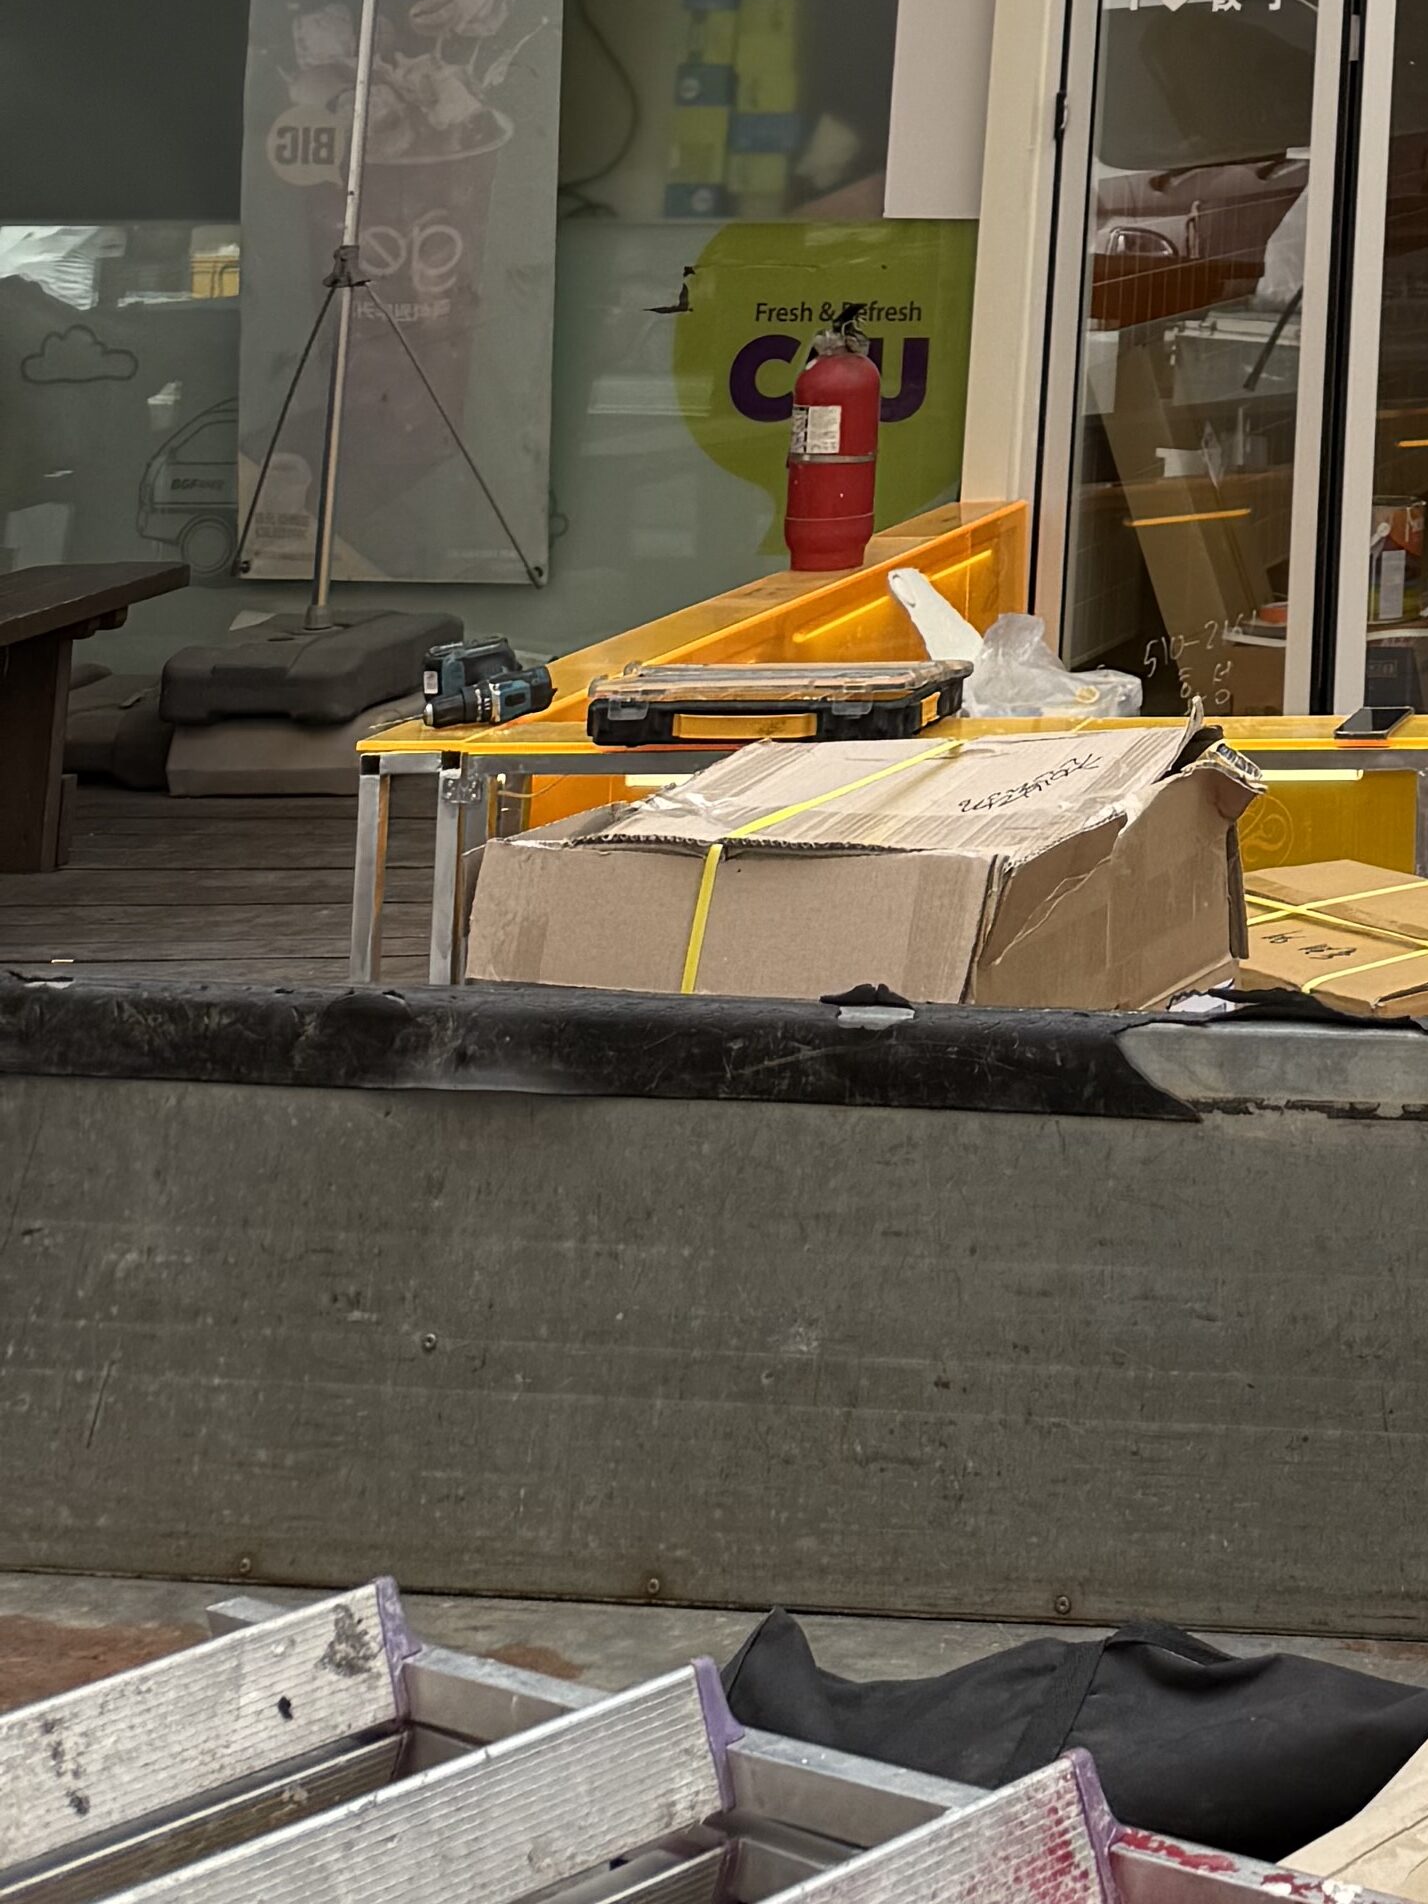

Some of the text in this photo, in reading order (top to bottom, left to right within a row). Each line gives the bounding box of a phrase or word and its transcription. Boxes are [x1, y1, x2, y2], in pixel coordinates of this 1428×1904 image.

[756, 302, 812, 322] Fresh
[819, 302, 835, 322] &
[729, 334, 930, 423] CU
